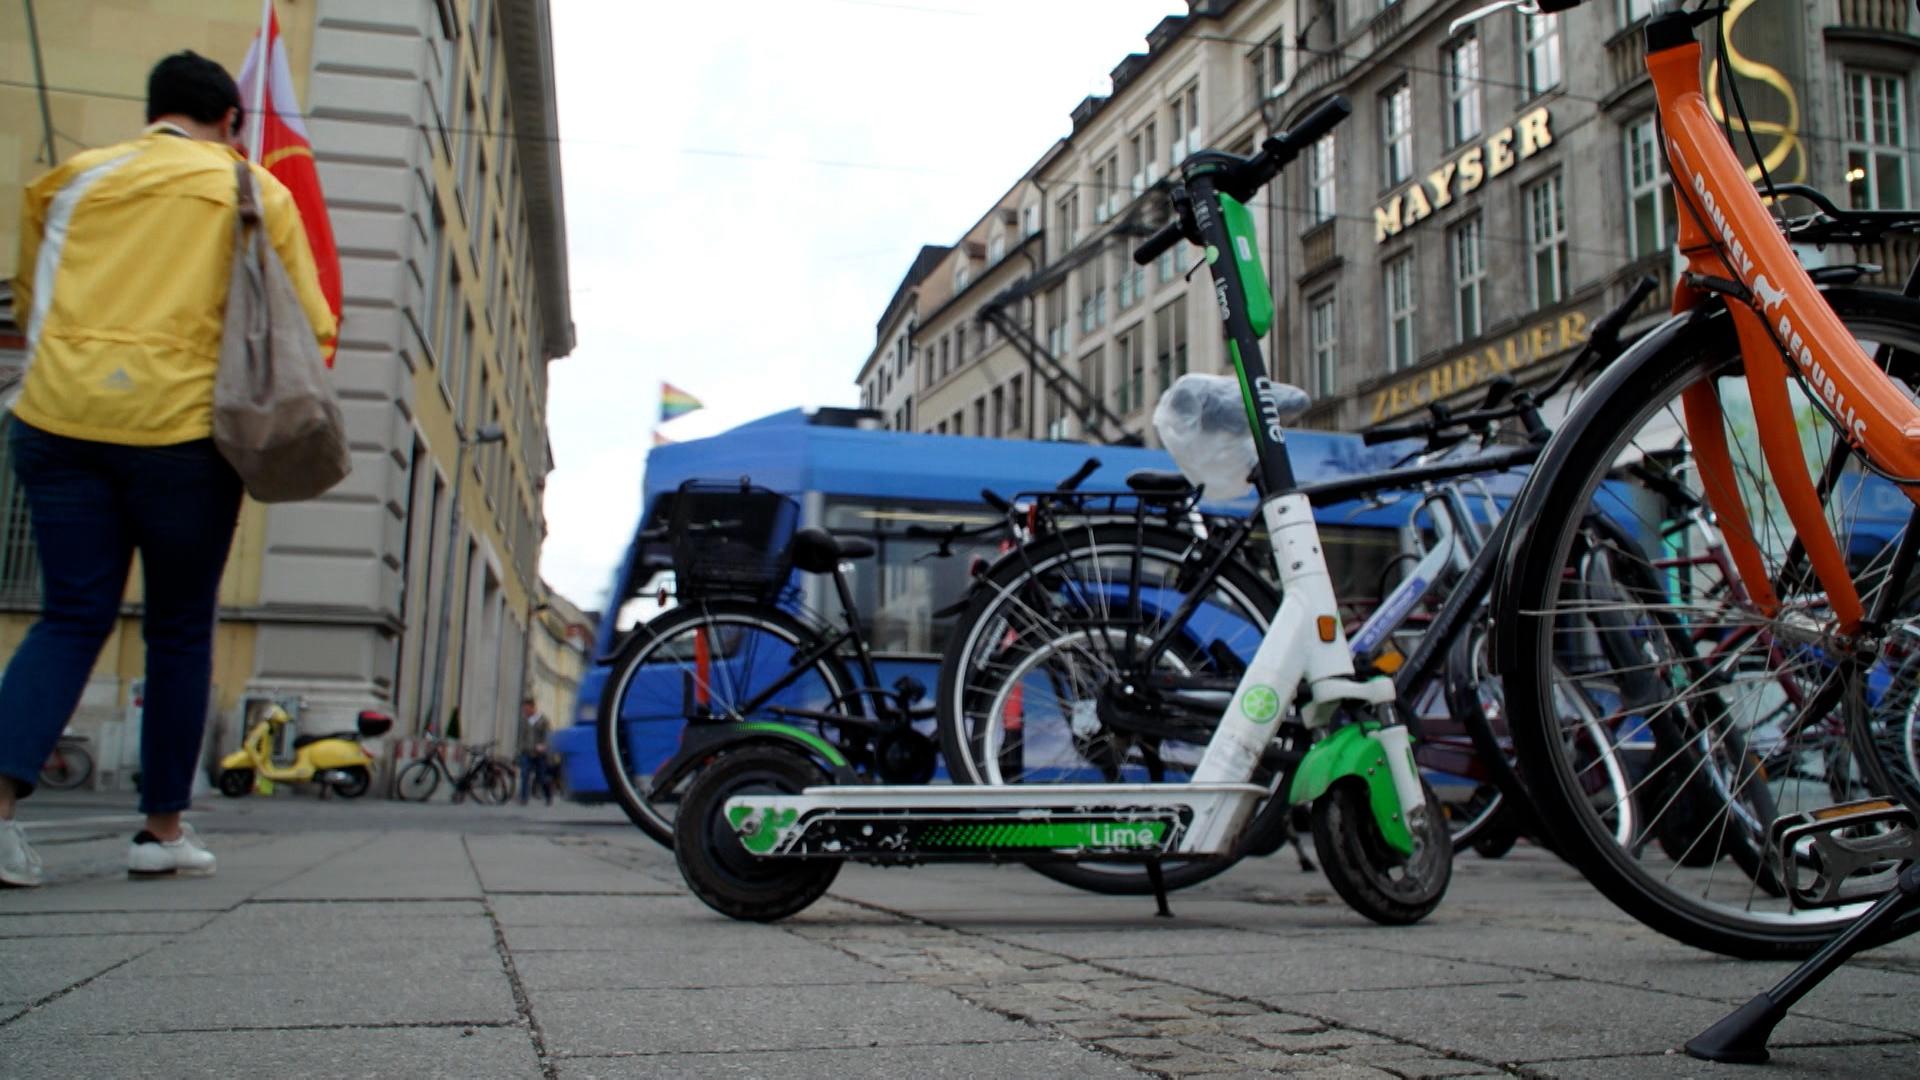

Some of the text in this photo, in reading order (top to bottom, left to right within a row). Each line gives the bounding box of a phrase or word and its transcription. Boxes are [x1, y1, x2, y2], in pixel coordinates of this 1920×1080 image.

[1374, 107, 1552, 244] MAYSER
[1694, 172, 1869, 443] DONKEY REPUBLIC
[1255, 376, 1286, 443] Lime
[1371, 311, 1588, 422] ZECHBAUER
[1090, 823, 1154, 847] Lime
